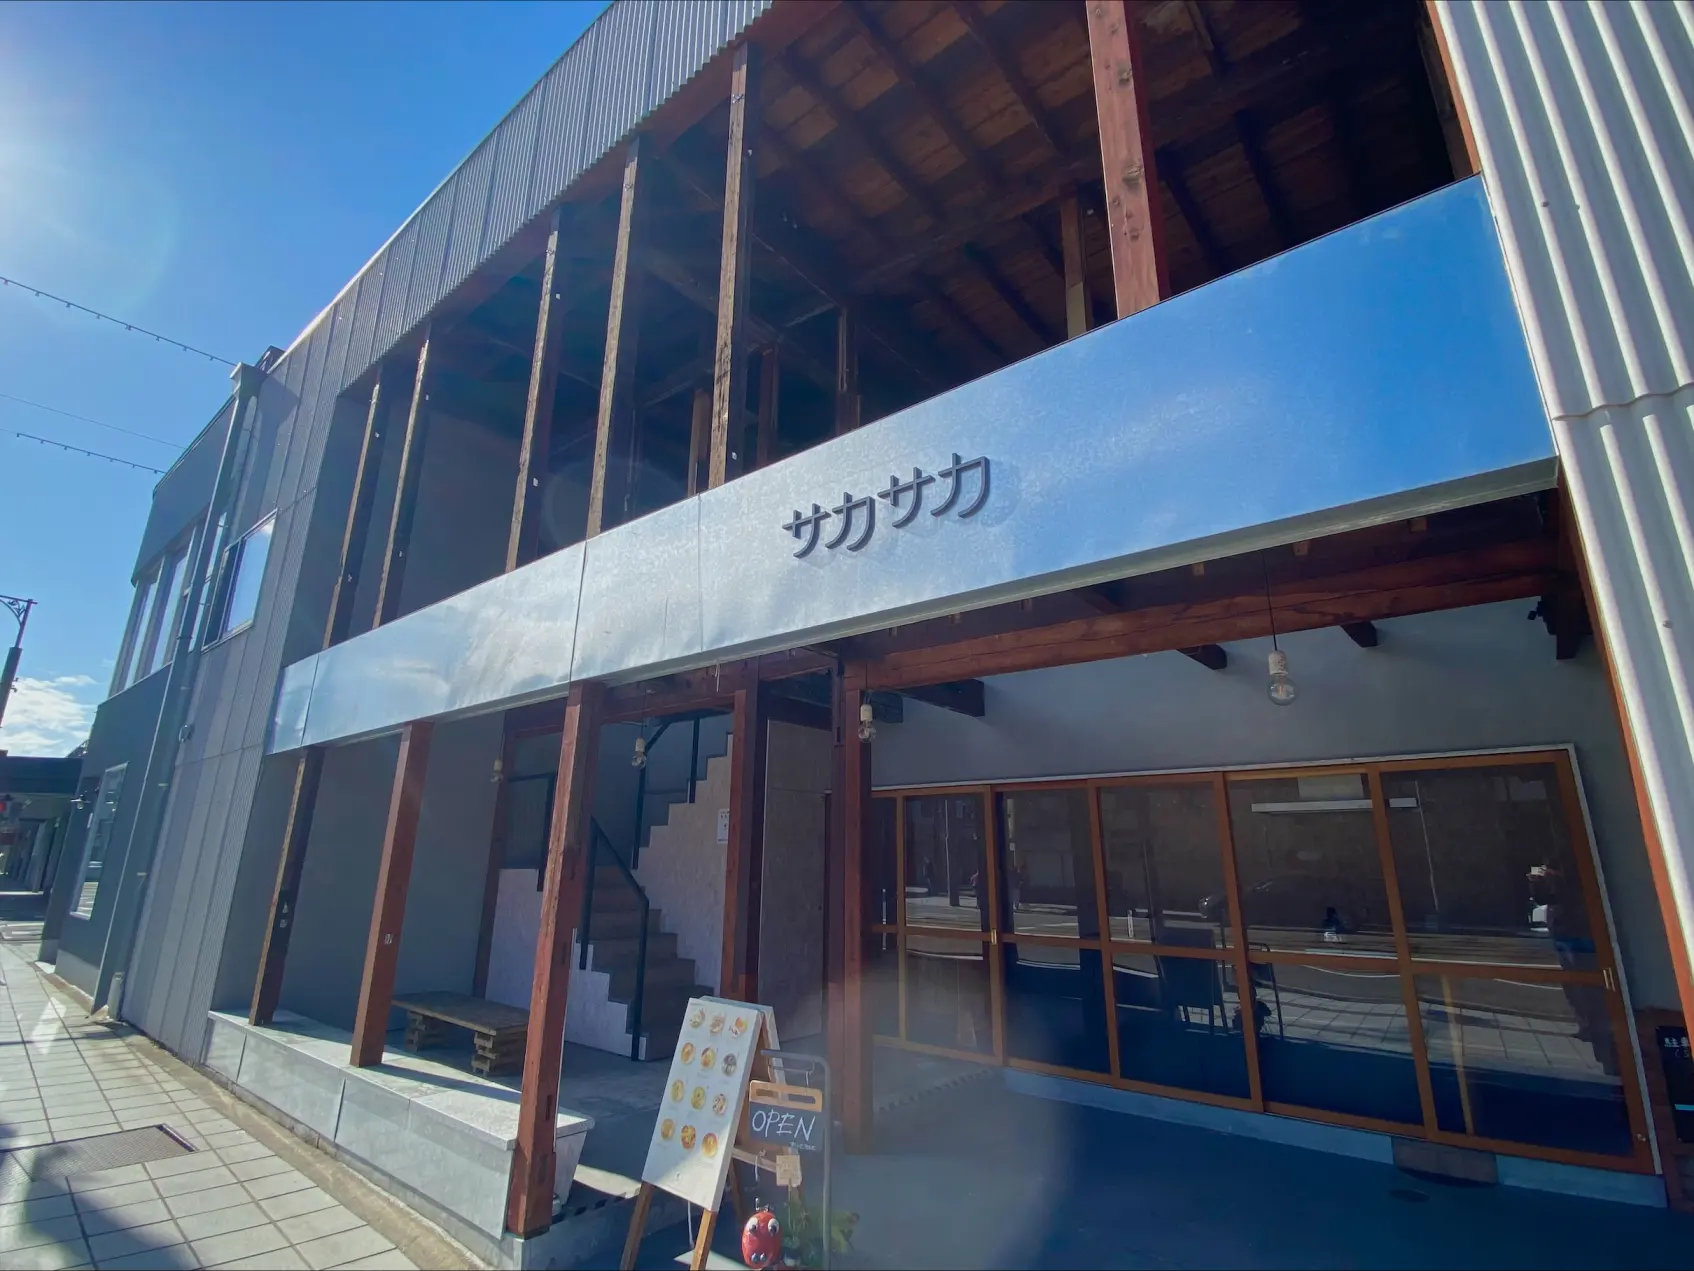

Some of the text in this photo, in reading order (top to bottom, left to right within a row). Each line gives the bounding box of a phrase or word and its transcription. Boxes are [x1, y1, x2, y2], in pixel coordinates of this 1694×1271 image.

[782, 453, 990, 558] サカサカ
[752, 1109, 816, 1141] OPEN
